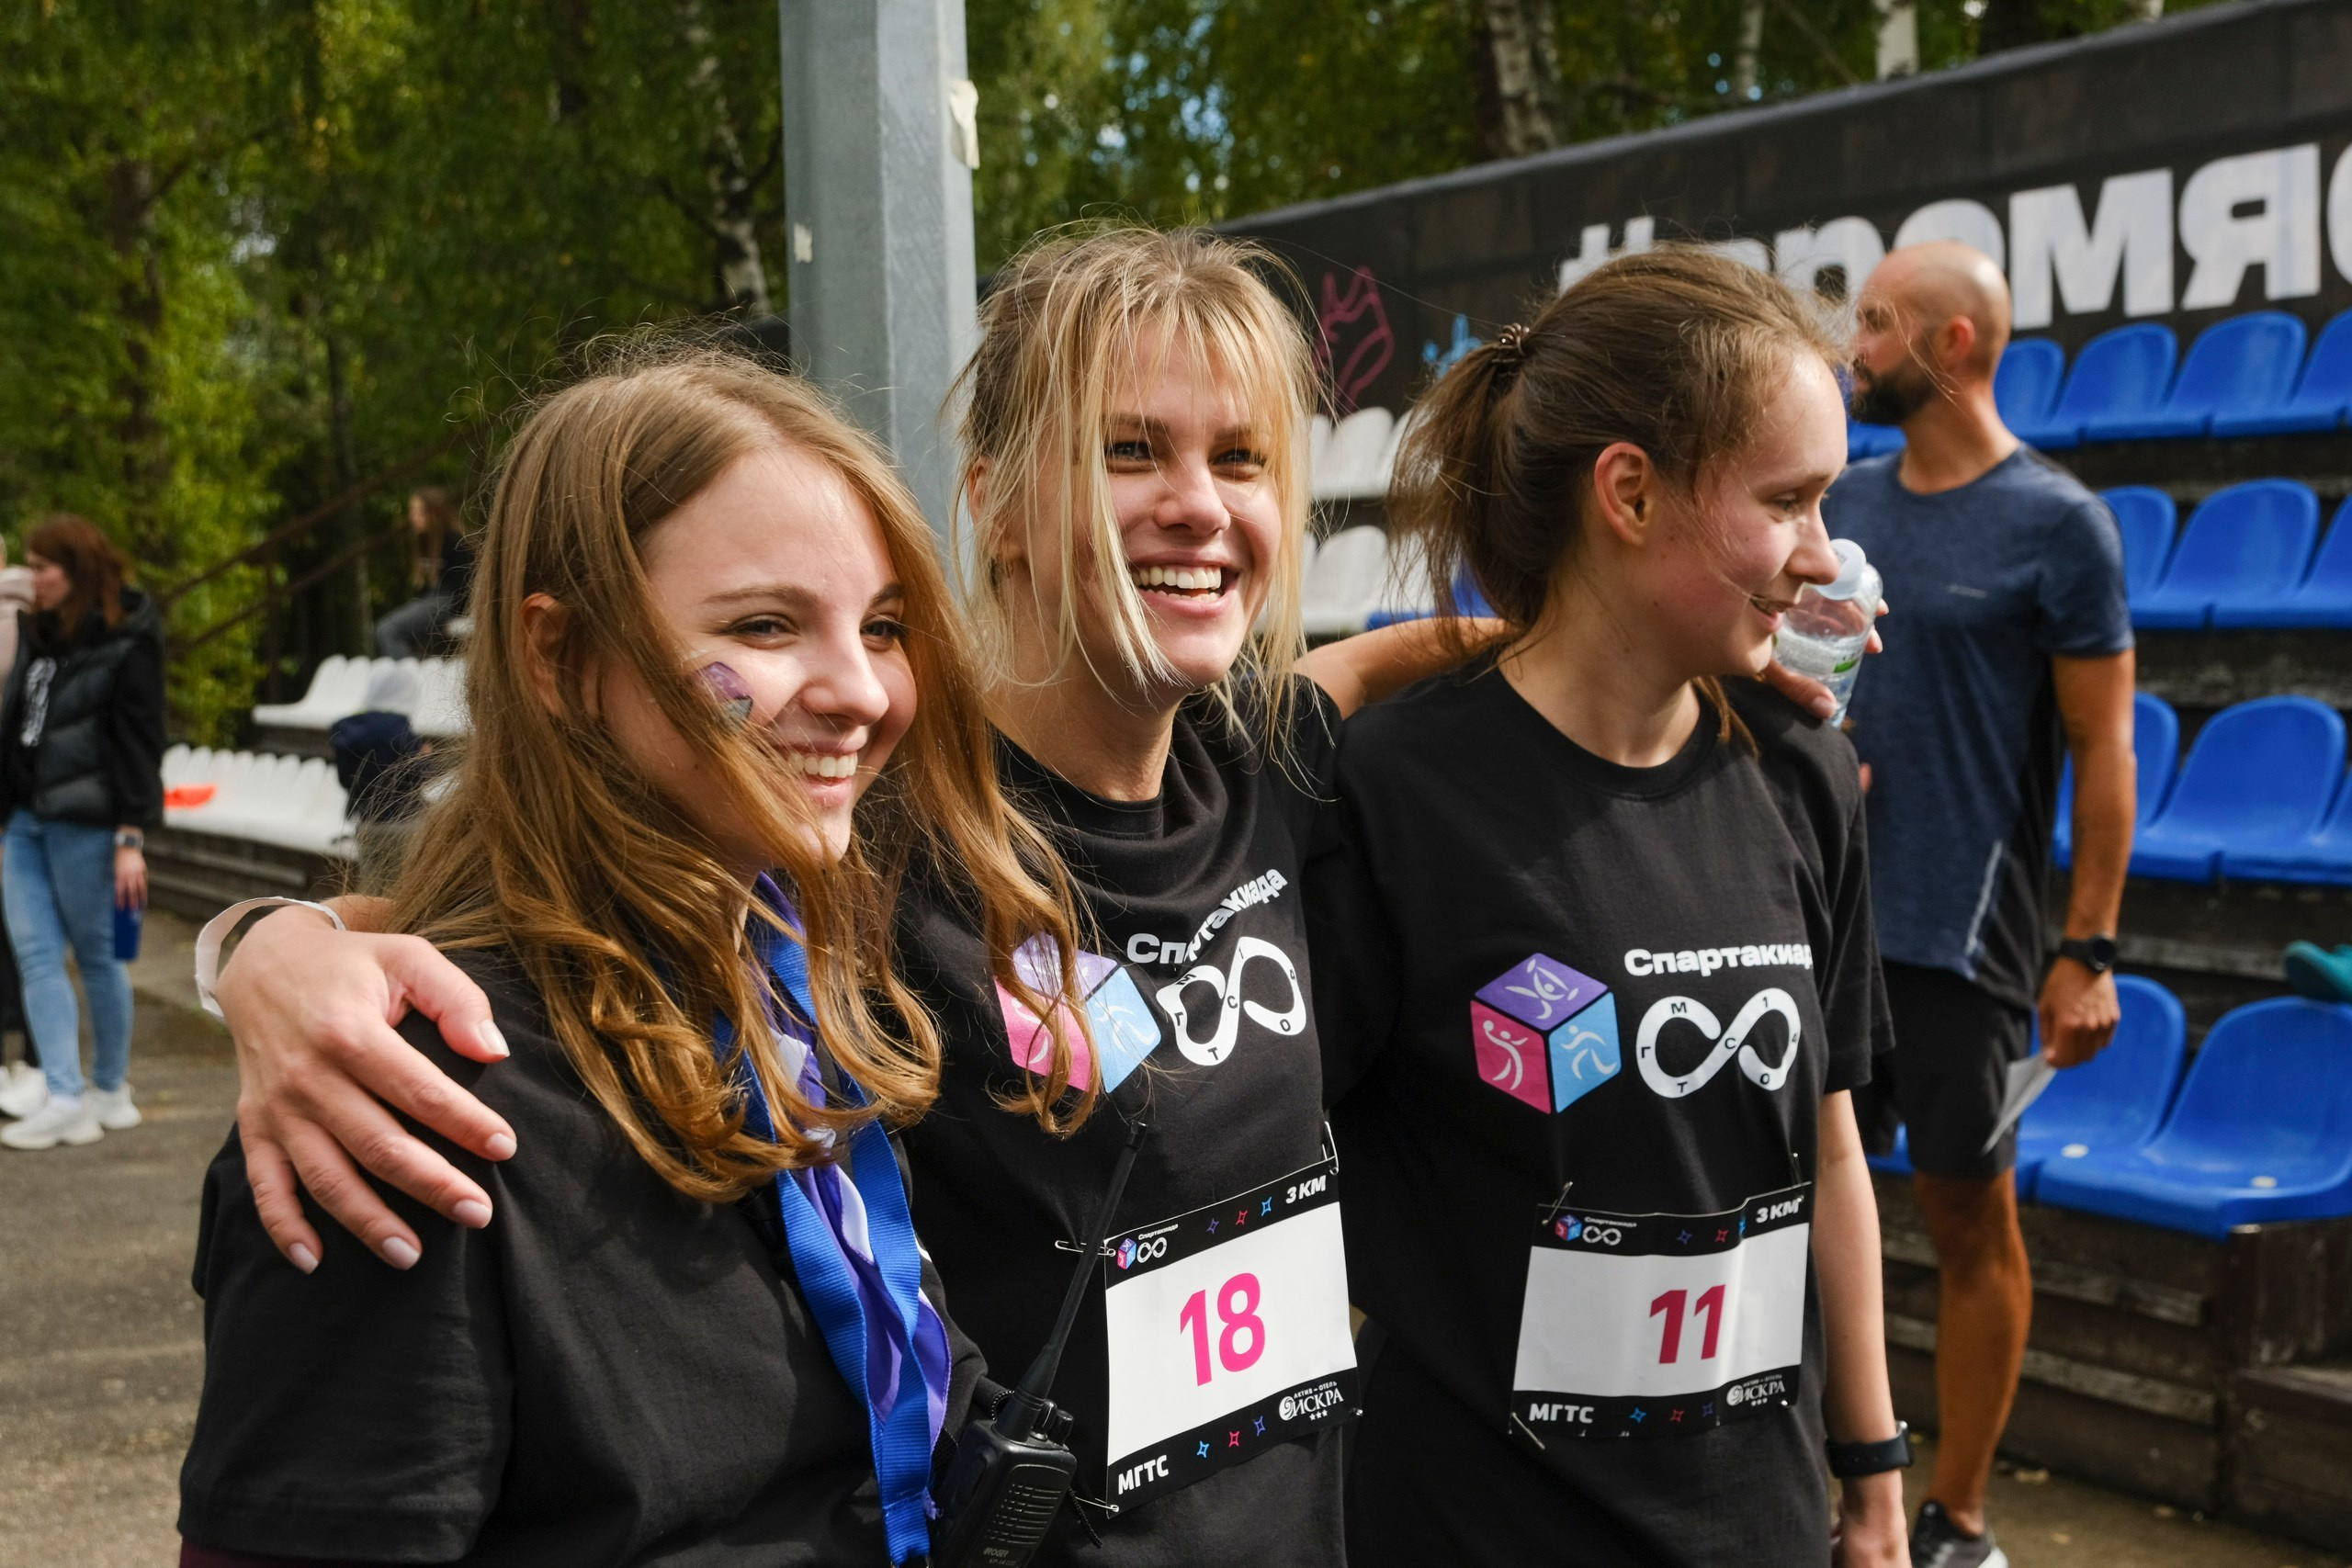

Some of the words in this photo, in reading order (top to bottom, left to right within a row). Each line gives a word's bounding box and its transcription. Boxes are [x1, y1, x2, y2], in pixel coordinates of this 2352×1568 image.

[1126, 868, 1288, 964] Спртакиада
[1286, 1186, 1297, 1204] 3
[1299, 1175, 1327, 1200] КМ
[1756, 1207, 1769, 1223] 3
[1770, 1199, 1799, 1220] КМ
[1180, 1272, 1266, 1387] 18
[1649, 1284, 1726, 1364] 11
[1292, 1387, 1344, 1416] ИСКРА
[1529, 1404, 1594, 1423] МГТС
[1117, 1455, 1170, 1495] МГТС
